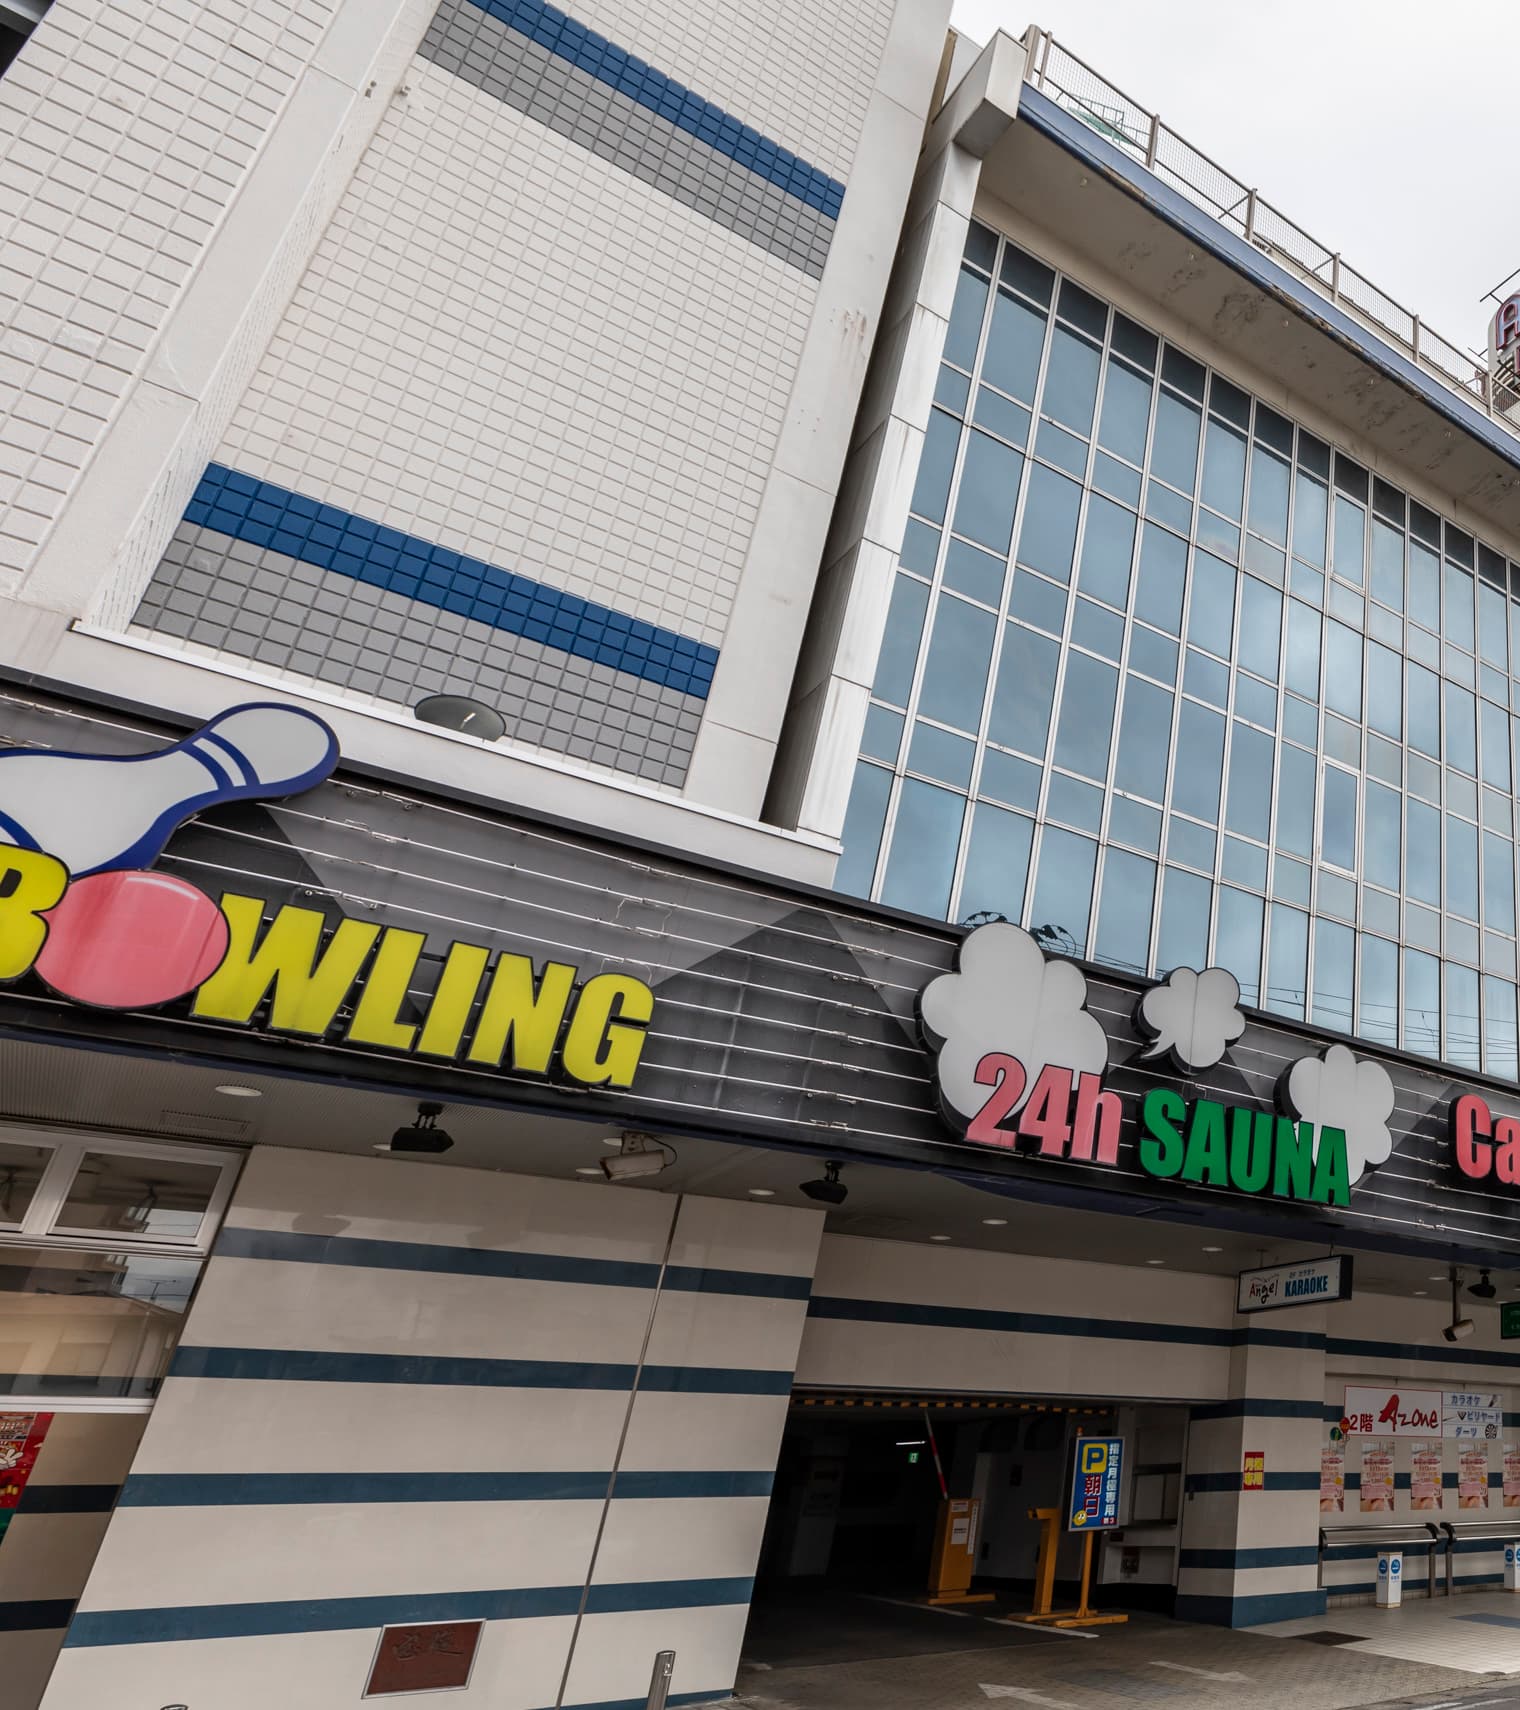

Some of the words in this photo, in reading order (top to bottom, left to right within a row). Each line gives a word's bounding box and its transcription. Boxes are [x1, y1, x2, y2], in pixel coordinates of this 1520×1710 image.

[963, 1051, 1123, 1166] 24h
[1139, 1087, 1351, 1208] SAUNA
[1249, 1279, 1279, 1305] Angel
[1284, 1275, 1329, 1298] KARAOKE
[1451, 1394, 1481, 1406] カラオケ
[1349, 1413, 1374, 1433] 2階
[1455, 1426, 1478, 1438] ダーツ
